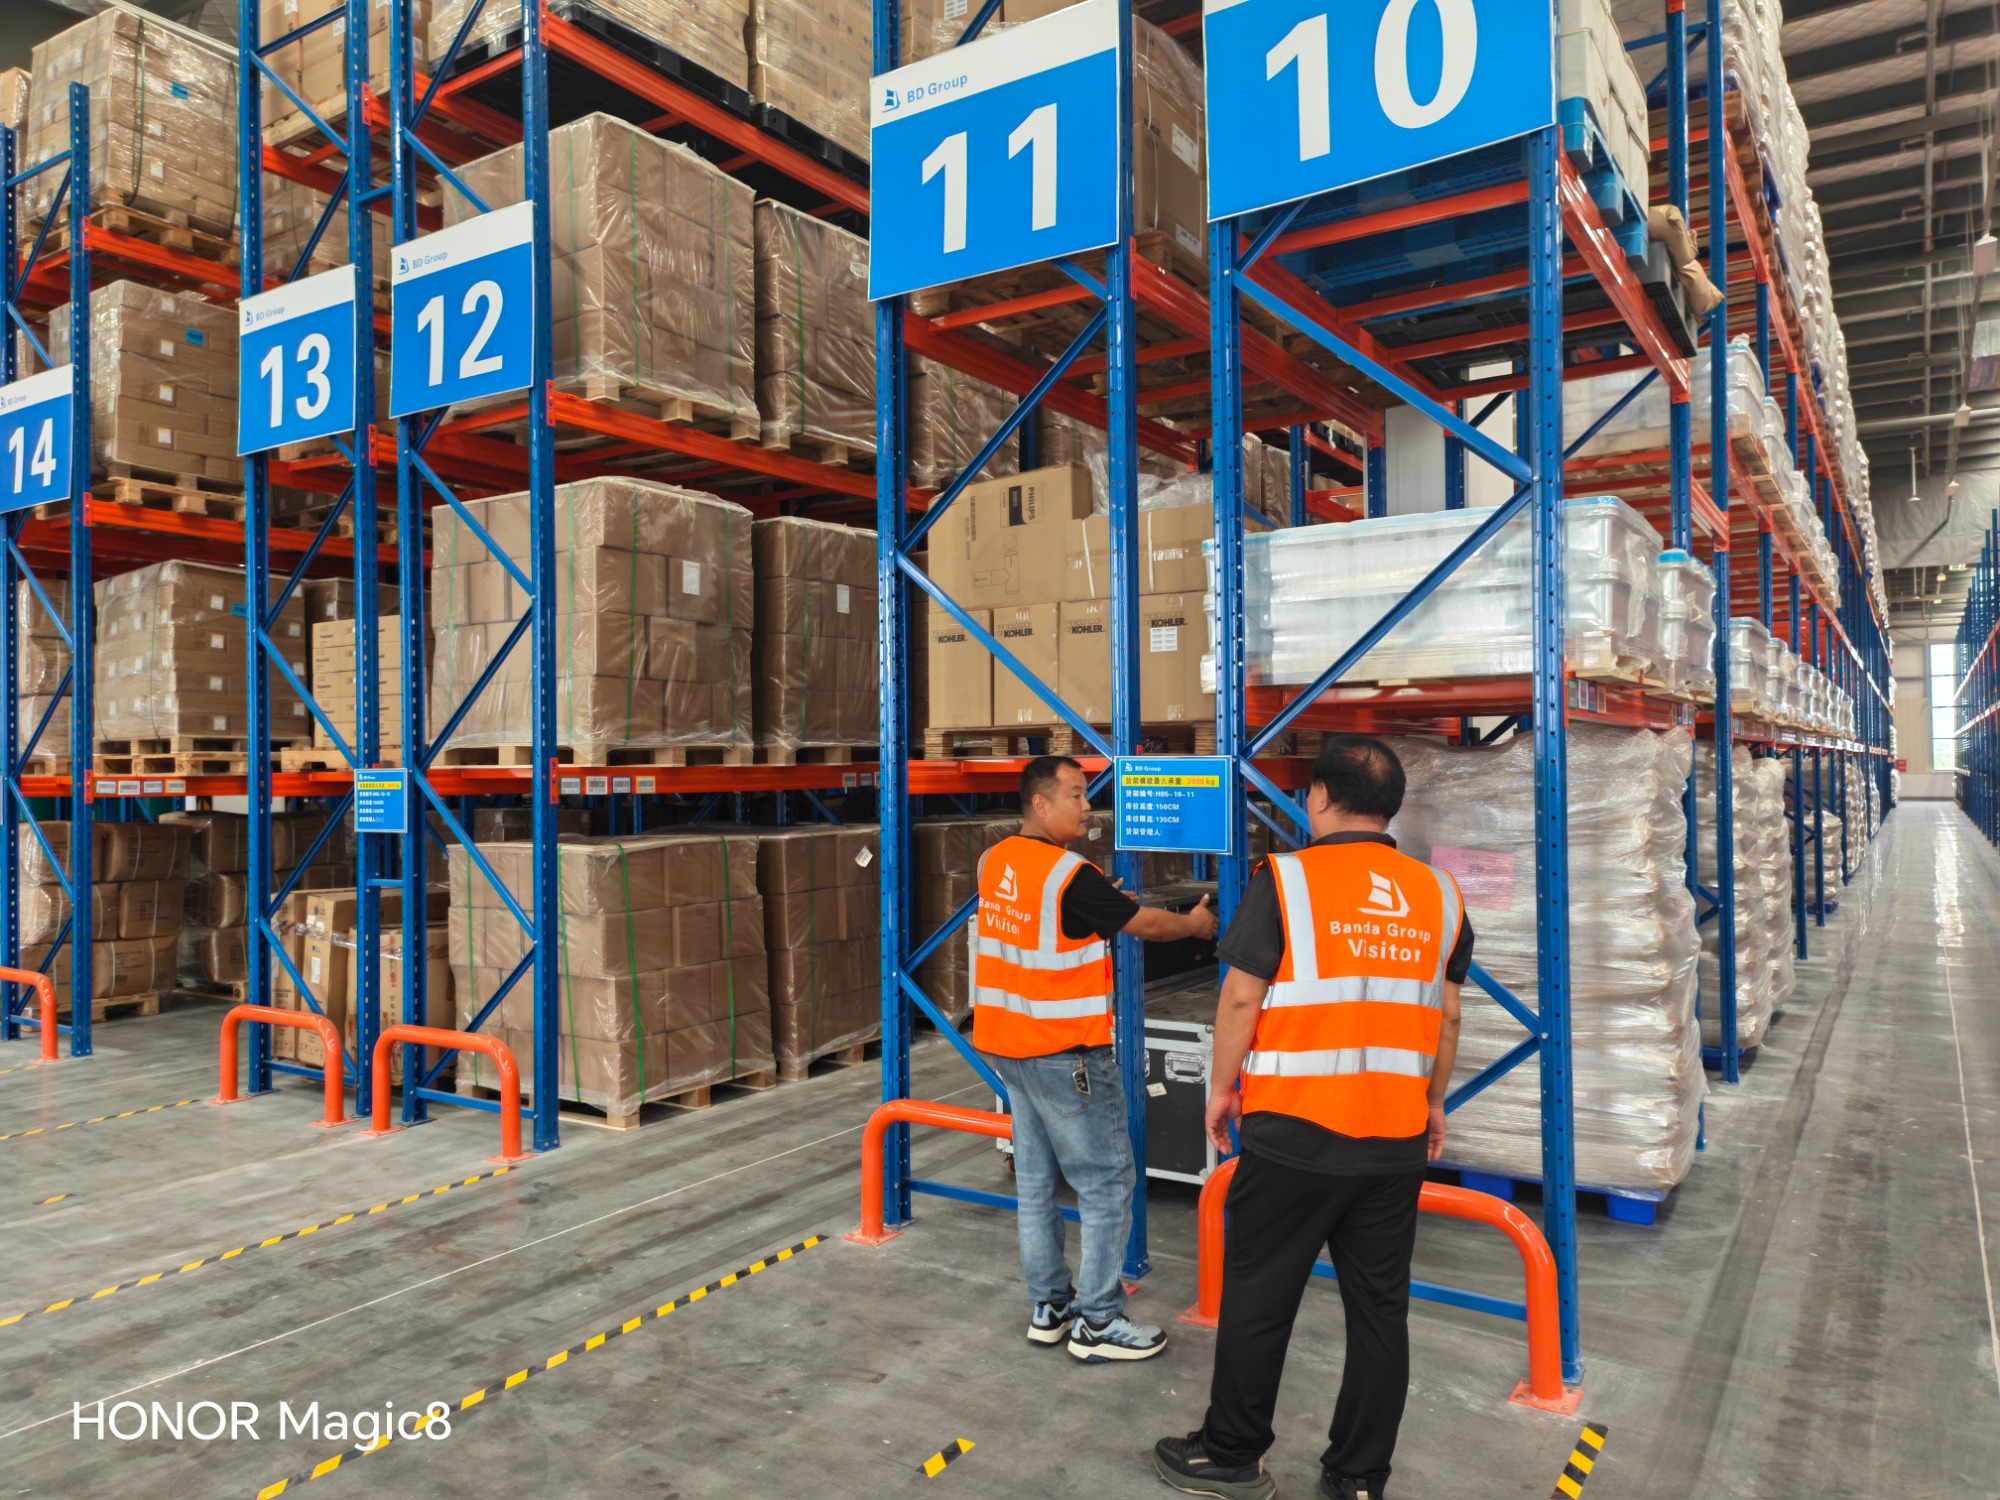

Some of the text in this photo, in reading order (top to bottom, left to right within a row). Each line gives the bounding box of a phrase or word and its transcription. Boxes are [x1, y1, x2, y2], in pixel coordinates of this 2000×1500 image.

[907, 74, 968, 103] BD Group
[1265, 0, 1478, 163] 10
[921, 102, 1058, 254] 11
[412, 251, 448, 269] BD Group
[255, 306, 285, 322] BD Group
[417, 279, 503, 387] 12
[260, 332, 331, 428] 13
[8, 417, 57, 494] 14
[1028, 486, 1036, 521] PHILIPS
[1003, 627, 1033, 638] KOHLER
[1071, 624, 1103, 635] KOHLER
[1151, 617, 1186, 628] KOHLER
[938, 634, 966, 643] KOHLER
[1143, 765, 1162, 773] Group
[1329, 920, 1431, 944] Banda Group
[1348, 938, 1422, 963] Visitor
